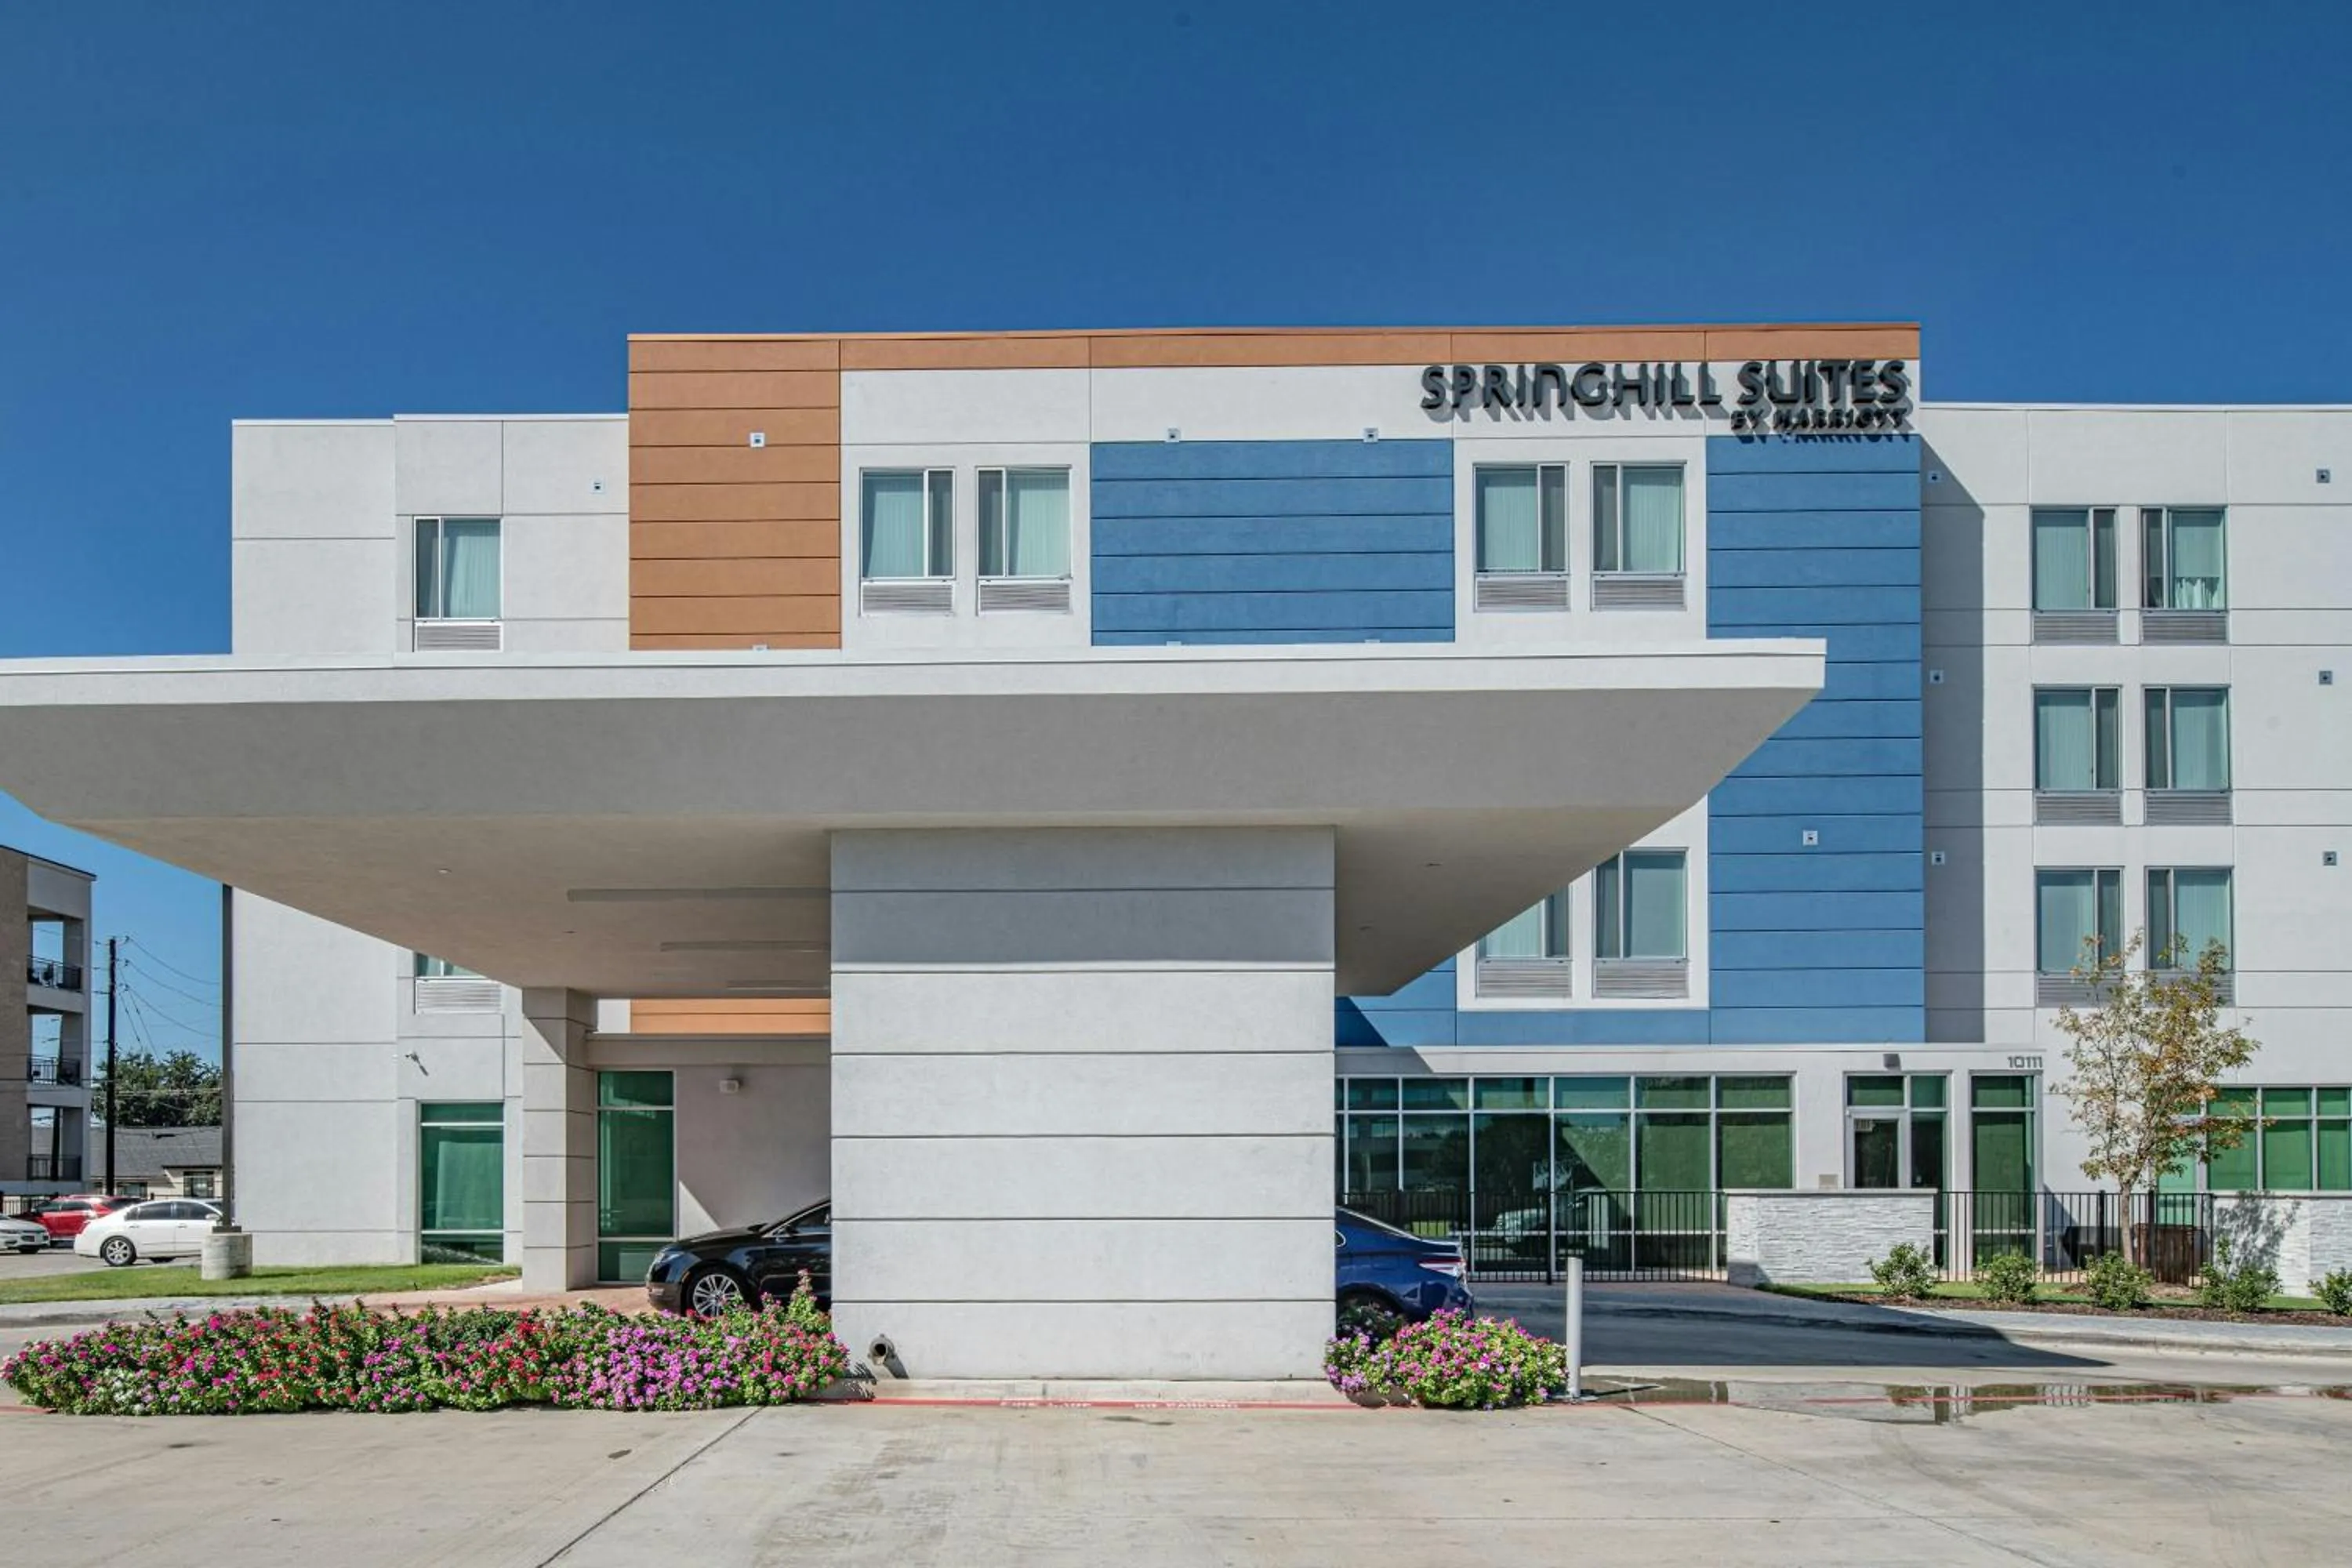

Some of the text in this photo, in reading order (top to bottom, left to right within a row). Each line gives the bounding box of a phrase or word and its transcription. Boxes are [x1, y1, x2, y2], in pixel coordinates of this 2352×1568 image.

[1421, 360, 1909, 408] SPRINGHILL SUITES
[1730, 407, 1908, 430] BY MARRIOTT
[2007, 1056, 2042, 1068] 10111
